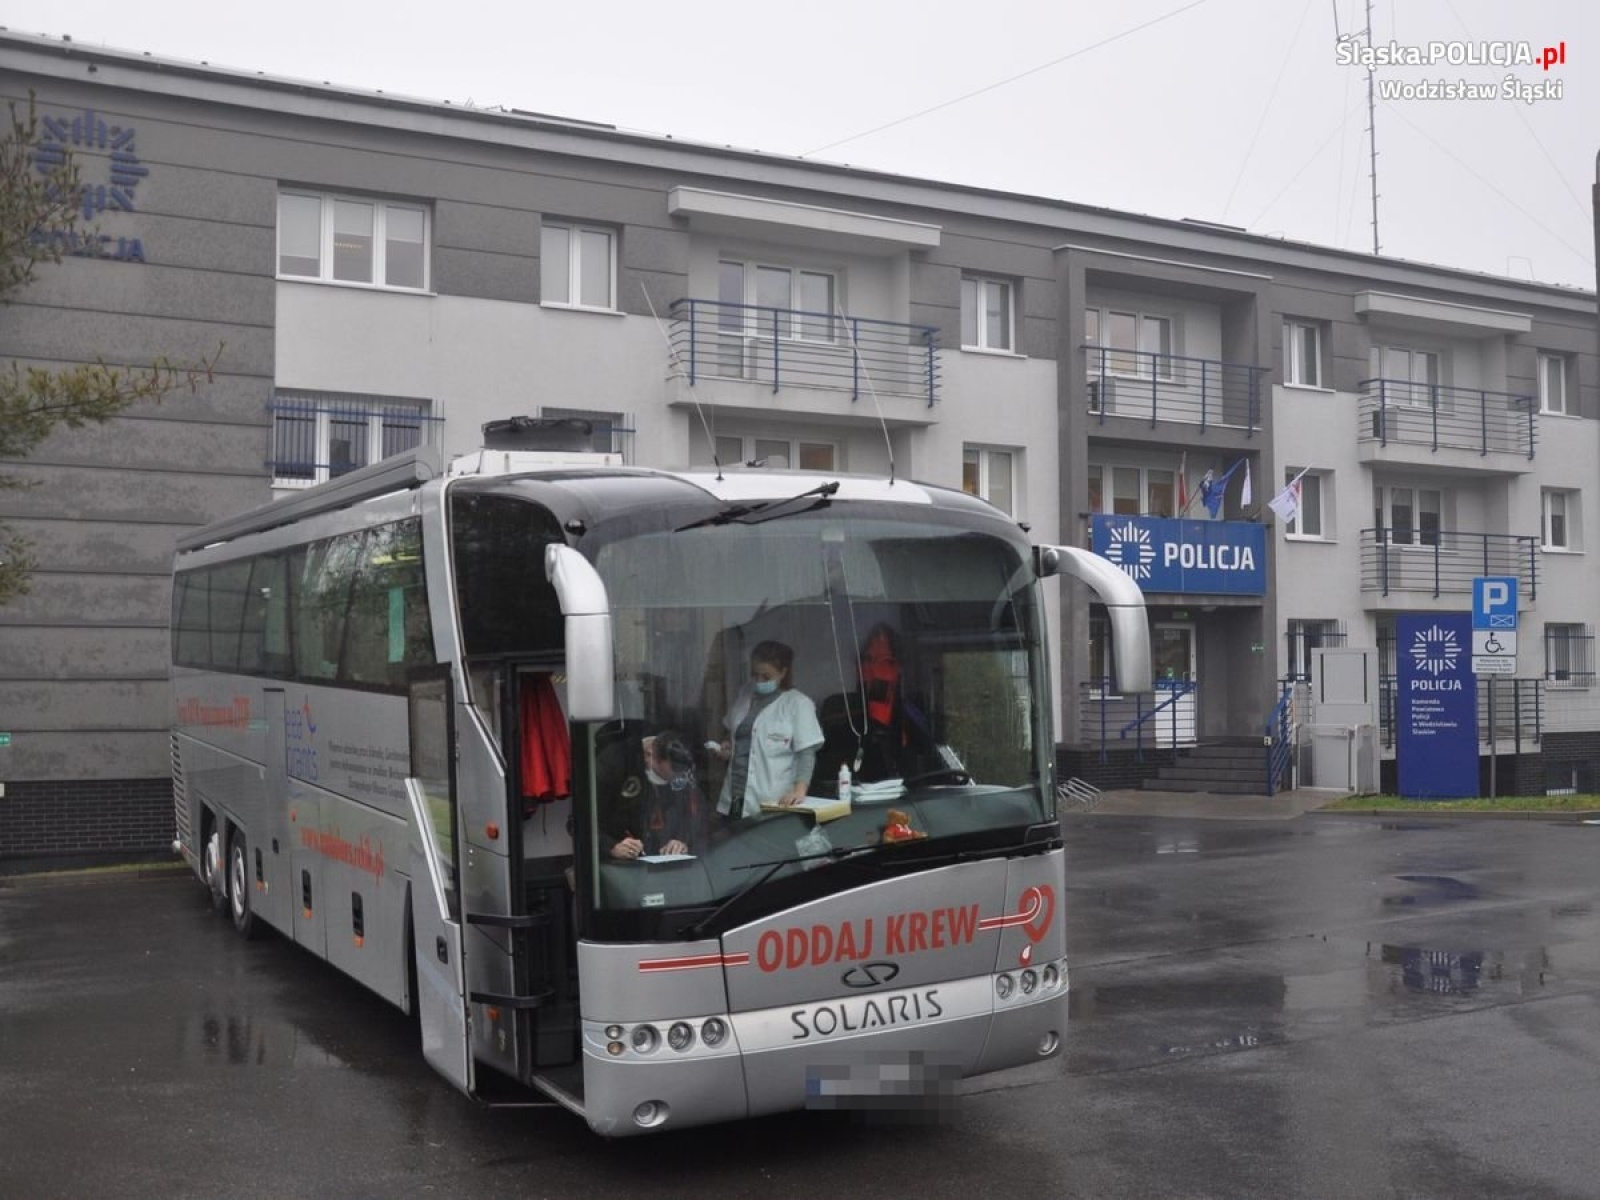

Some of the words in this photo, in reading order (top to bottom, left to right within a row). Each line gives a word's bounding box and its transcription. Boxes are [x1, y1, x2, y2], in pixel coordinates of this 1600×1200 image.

[1163, 541, 1256, 571] POLICJA
[1483, 581, 1509, 614] P
[1411, 679, 1462, 691] POLICJA
[757, 918, 873, 973] ODDAJ
[886, 904, 979, 955] KREW
[791, 990, 943, 1040] SOLARIS
